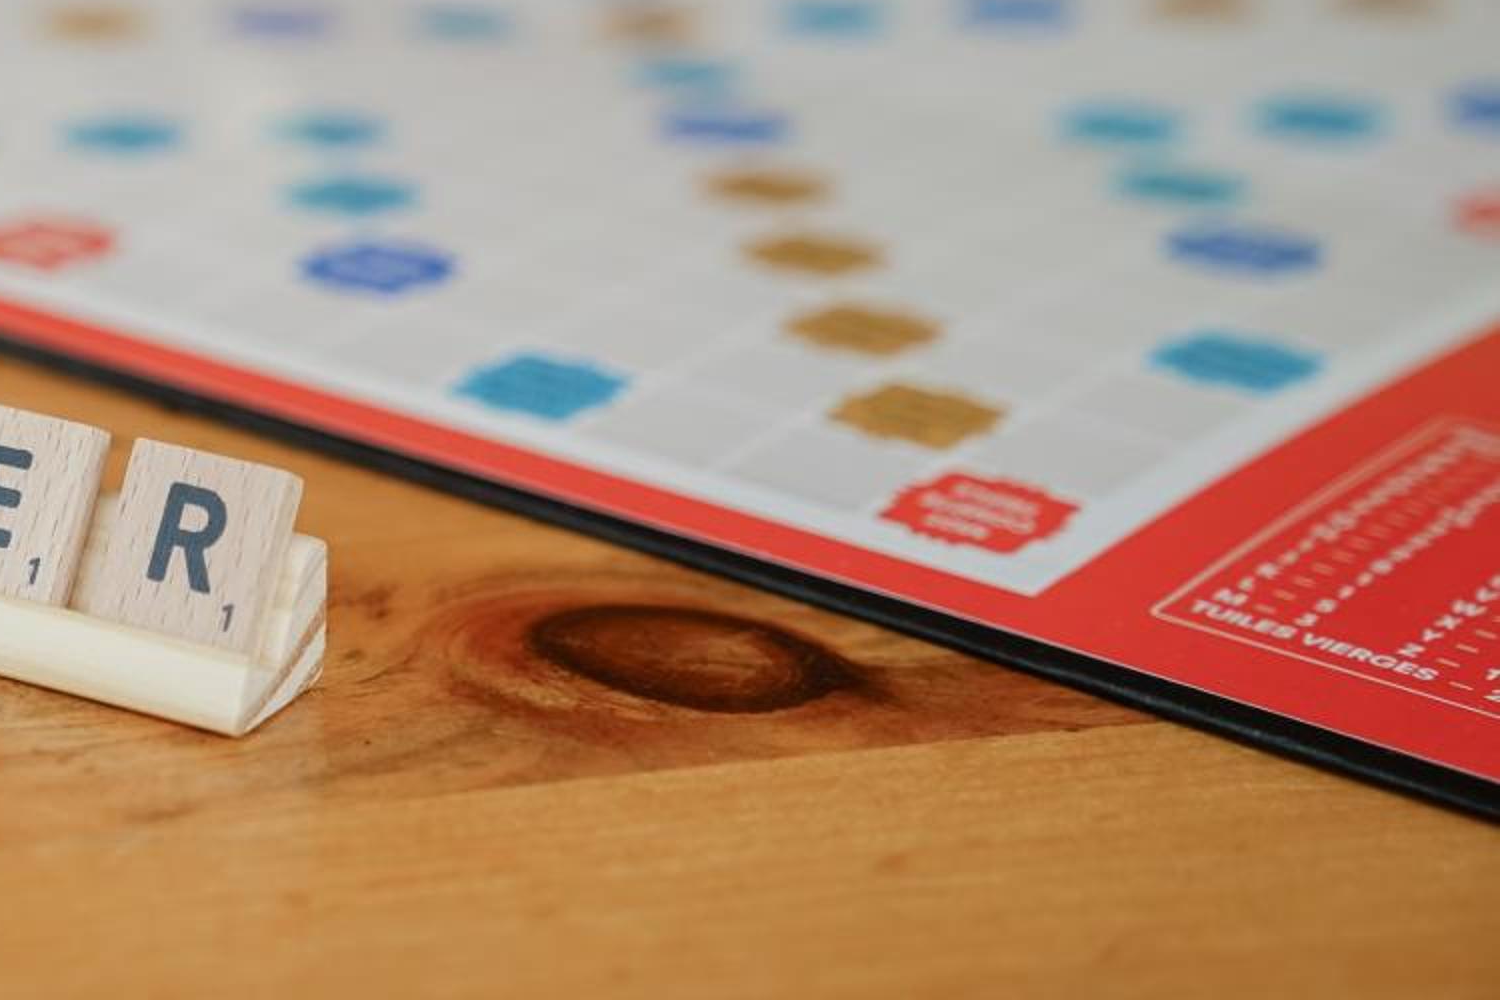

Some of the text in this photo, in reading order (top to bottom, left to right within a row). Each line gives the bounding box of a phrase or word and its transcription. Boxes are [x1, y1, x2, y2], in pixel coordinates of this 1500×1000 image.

[27, 556, 42, 586] 1
[221, 603, 235, 634] 1
[1190, 600, 1440, 681] TUILES VIERGES
